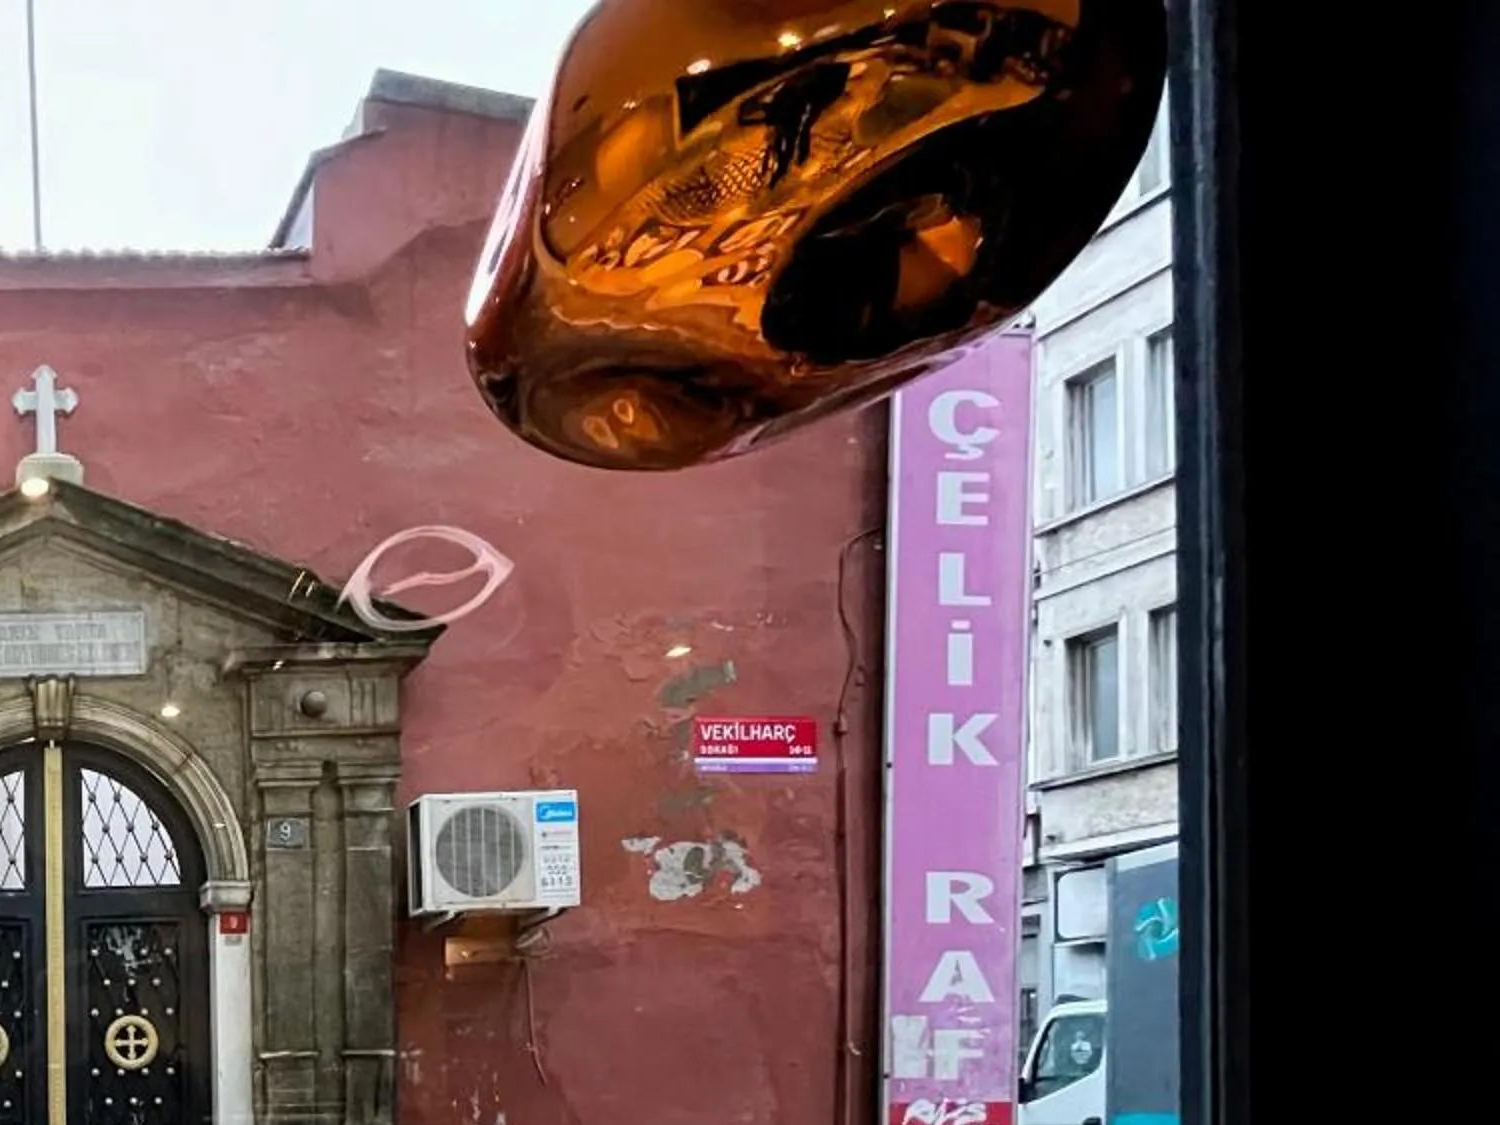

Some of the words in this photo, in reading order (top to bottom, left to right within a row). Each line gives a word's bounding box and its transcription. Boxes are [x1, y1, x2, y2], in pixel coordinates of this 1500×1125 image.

[928, 390, 1000, 766] ÇELİK
[700, 721, 796, 743] VEKİLHARÇ
[280, 821, 291, 840] 9
[919, 871, 995, 1080] RAF
